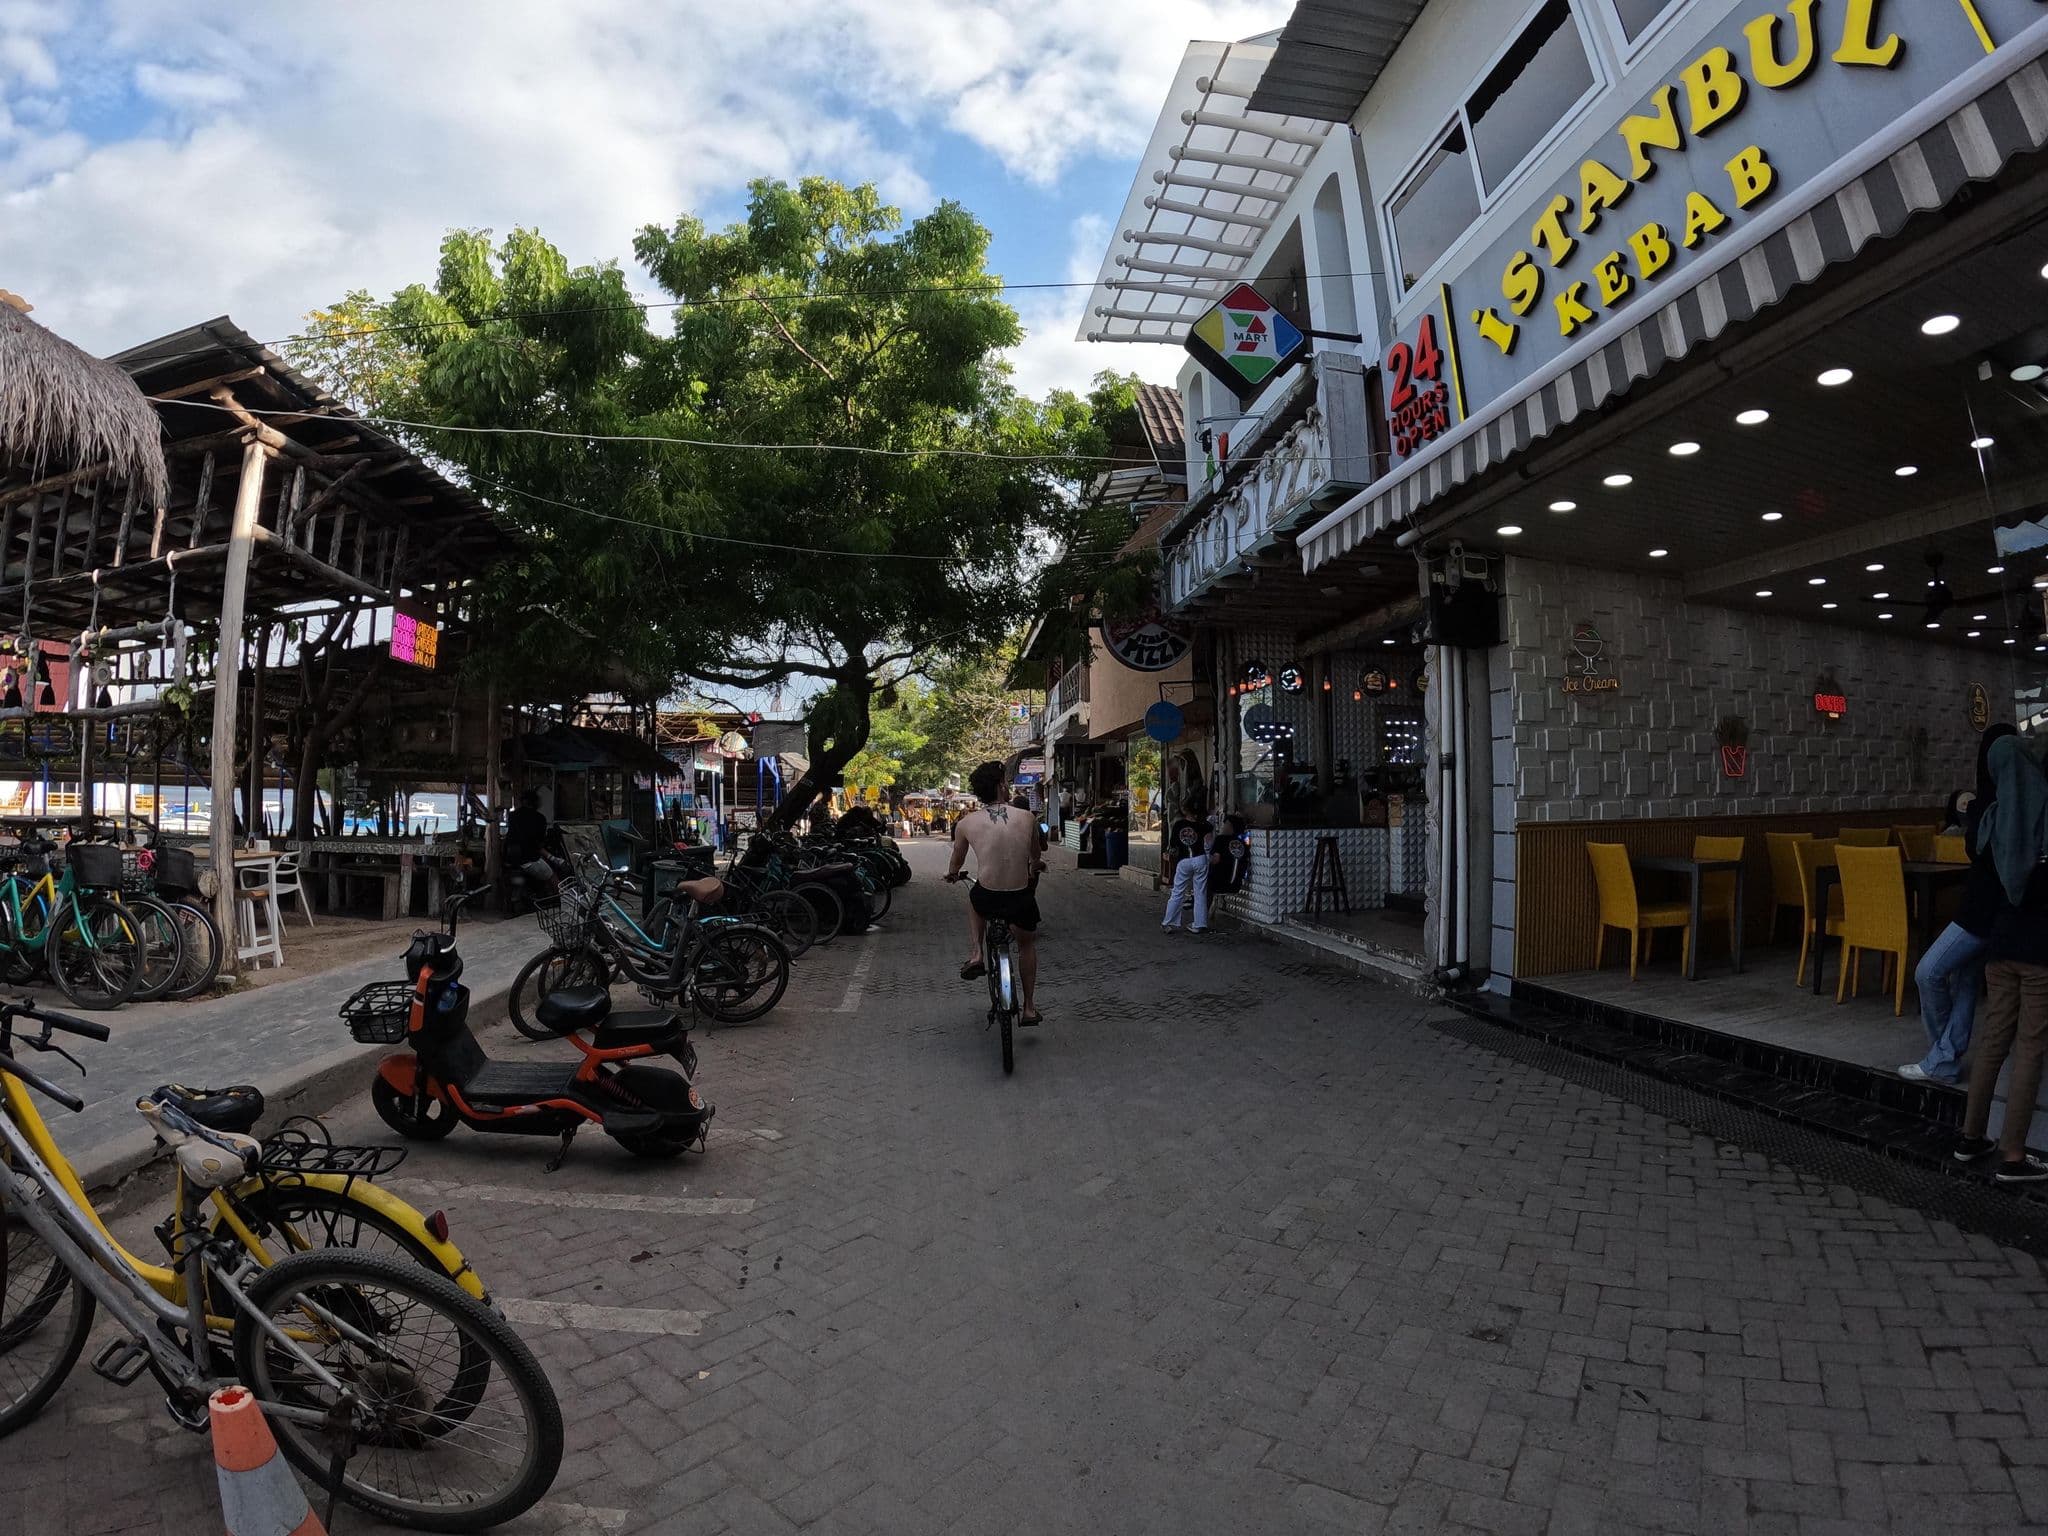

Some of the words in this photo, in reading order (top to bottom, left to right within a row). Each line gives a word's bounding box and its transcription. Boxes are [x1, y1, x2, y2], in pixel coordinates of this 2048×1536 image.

[1553, 145, 1776, 337] KEBAB
[1233, 331, 1268, 342] MART
[1388, 313, 1443, 412] 24
[1391, 381, 1449, 436] HOURS
[1397, 406, 1450, 457] OPEN
[1120, 635, 1187, 666] PIZZA
[1562, 676, 1579, 692] Ice
[1583, 675, 1619, 691] Cream
